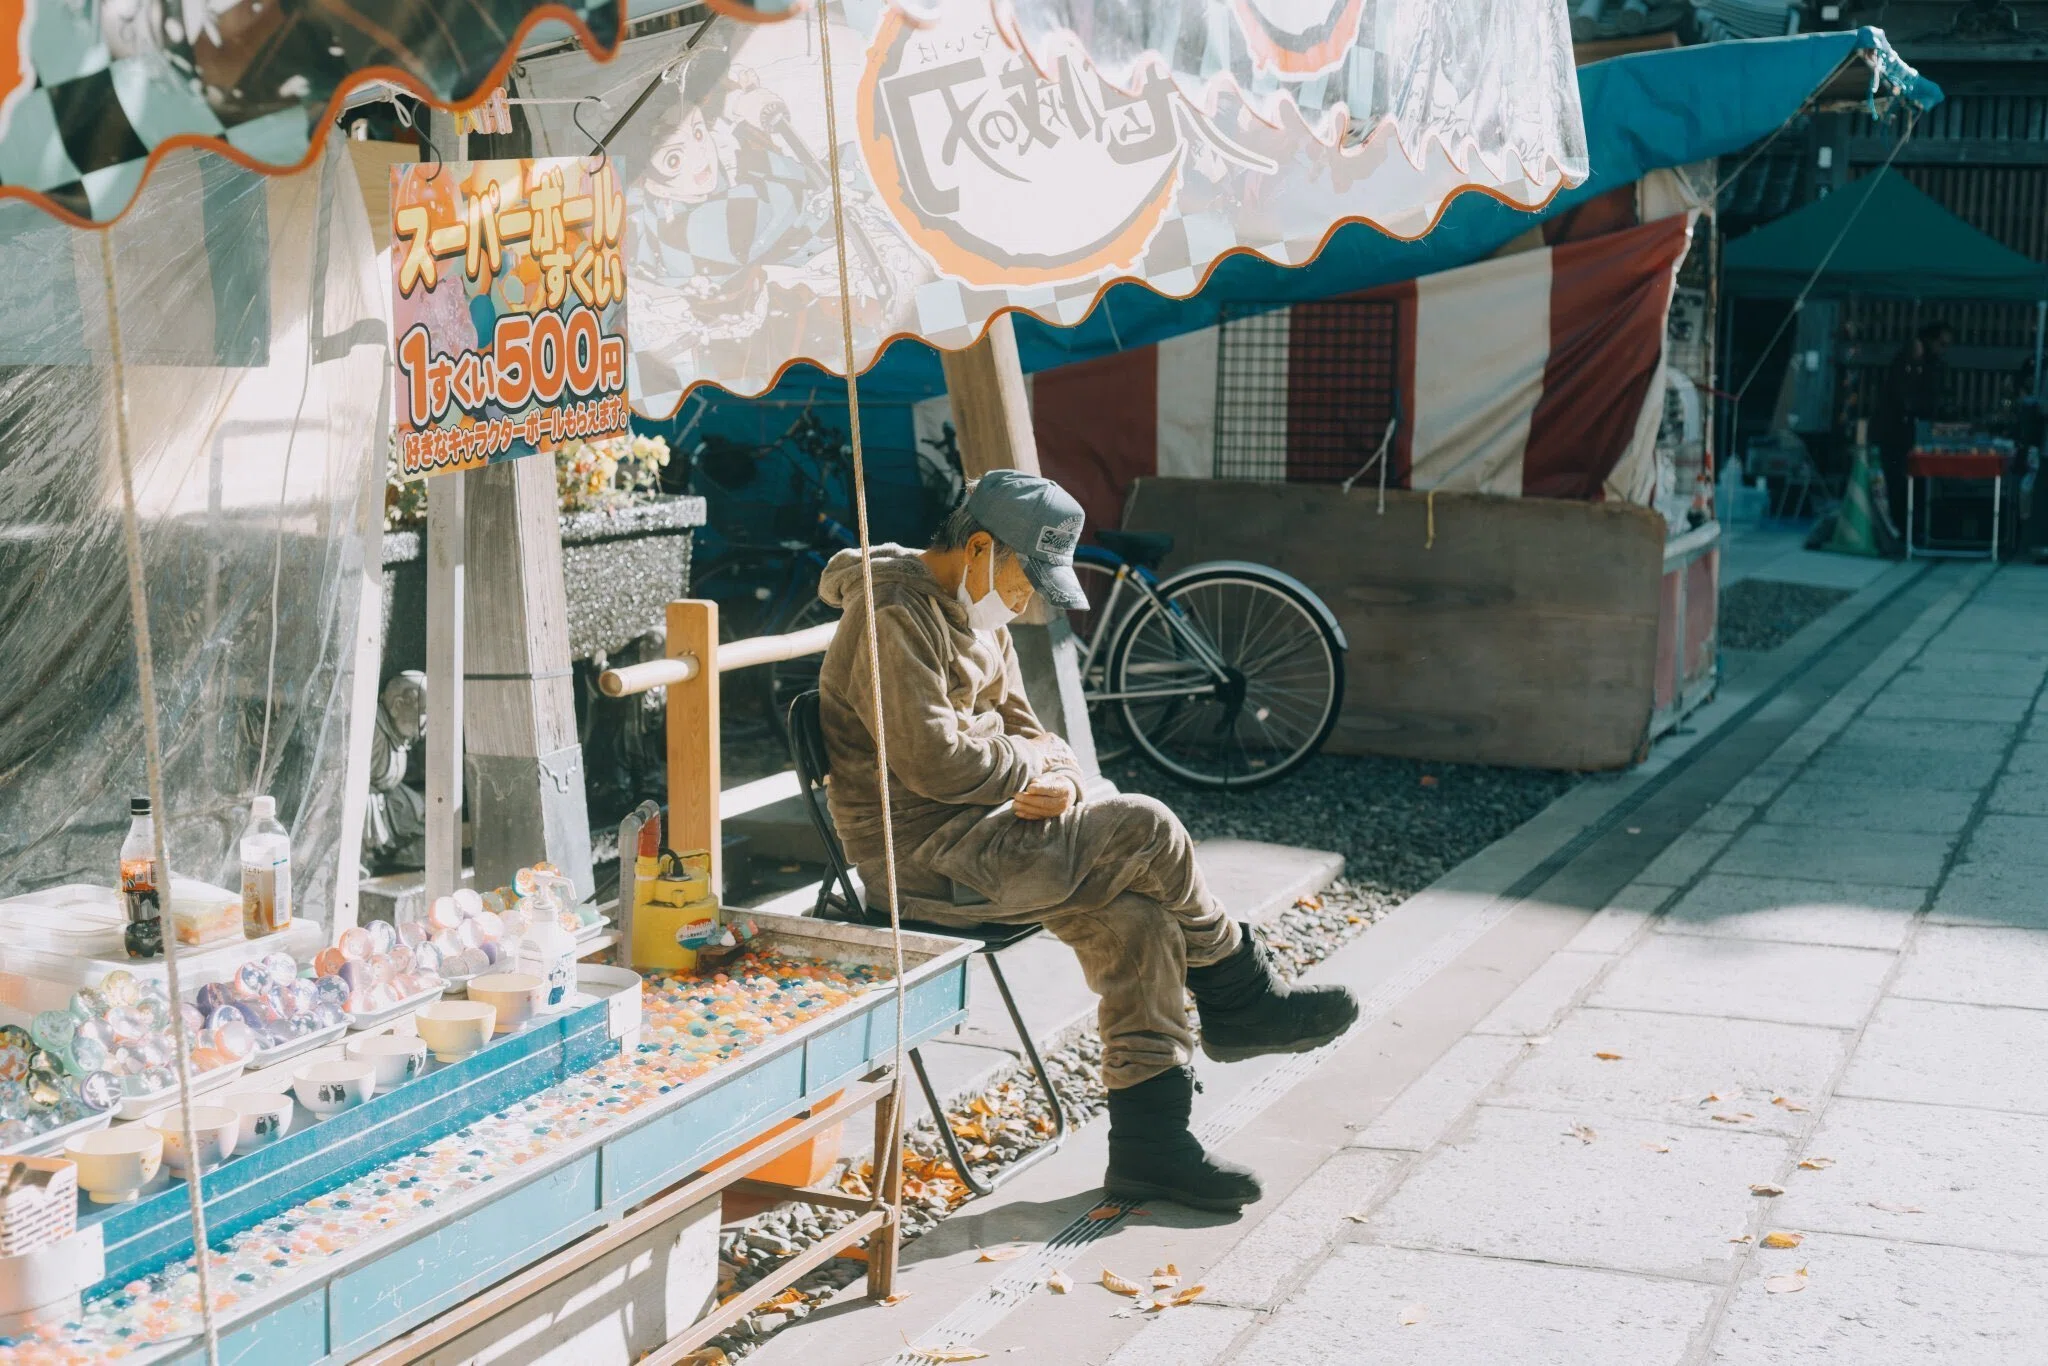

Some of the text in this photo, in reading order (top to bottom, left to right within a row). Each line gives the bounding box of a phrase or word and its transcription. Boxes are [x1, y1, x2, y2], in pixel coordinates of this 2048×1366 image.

[397, 164, 624, 299] スーパーボール
[540, 247, 624, 310] すくい
[399, 304, 626, 431] 1すくい500円
[402, 394, 628, 472] 好きなキャラクターボールもらえます。
